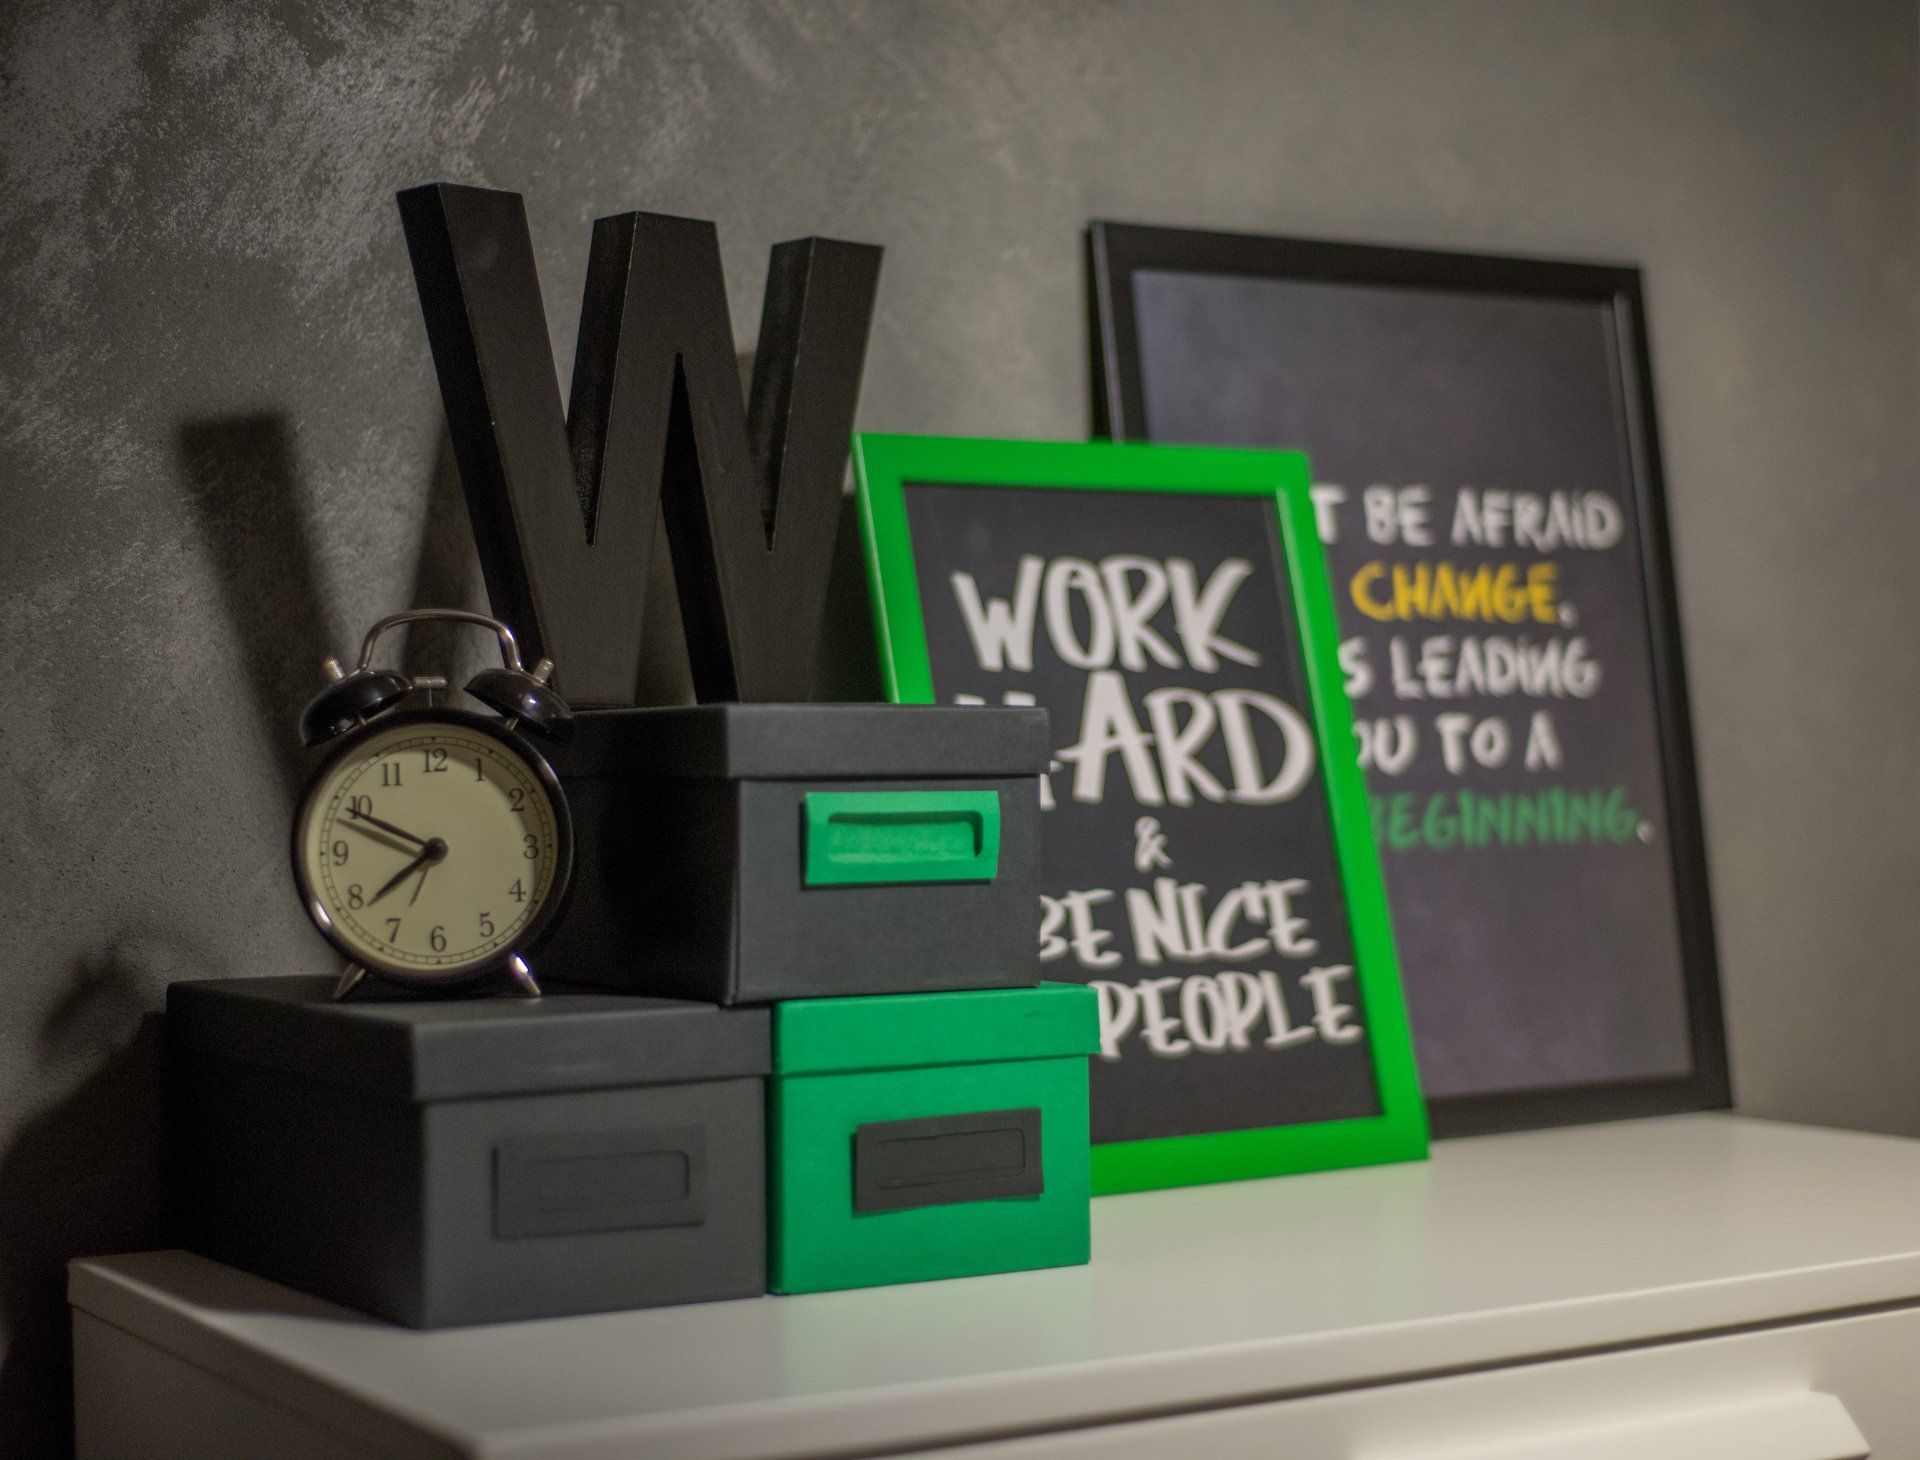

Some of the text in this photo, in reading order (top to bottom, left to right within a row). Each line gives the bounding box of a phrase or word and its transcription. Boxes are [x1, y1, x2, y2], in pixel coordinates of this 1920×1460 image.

[1363, 483, 1434, 547] BE
[1350, 560, 1578, 628] CHANGE.
[951, 553, 1262, 672] WORK
[1389, 634, 1600, 700] LEADING
[953, 669, 1315, 810] ARD
[1435, 711, 1509, 774] TO
[1525, 709, 1562, 772] A
[422, 748, 448, 772] 12
[475, 758, 486, 782] 1
[381, 762, 402, 786] 11
[350, 794, 372, 820] 10
[509, 788, 525, 812] 2
[1369, 785, 1655, 850] EGINNING.
[333, 840, 348, 866] 9
[523, 834, 539, 860] 3
[1134, 816, 1172, 872] &
[348, 884, 364, 910] 8
[508, 878, 526, 902] 4
[386, 918, 402, 942] 7
[479, 912, 494, 937] 5
[1126, 877, 1317, 965] NICE
[431, 926, 446, 952] 6
[1099, 964, 1363, 1061] PEOPLE
